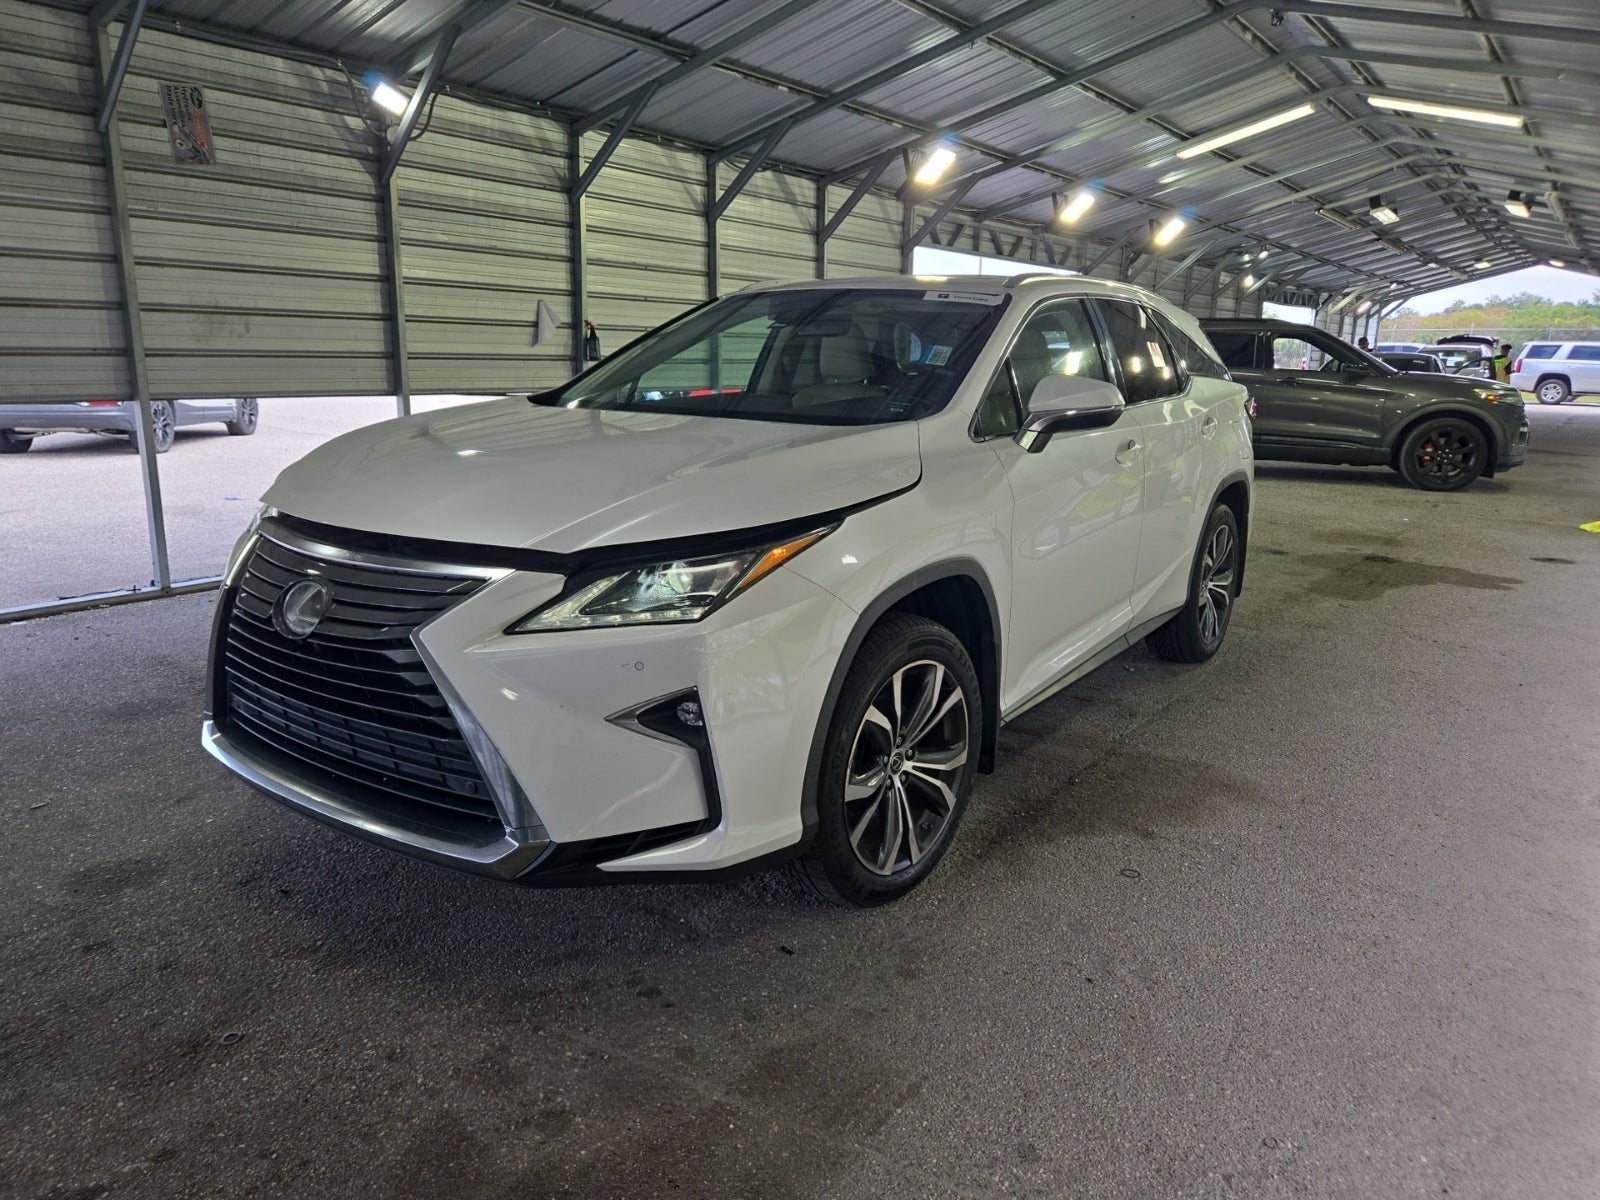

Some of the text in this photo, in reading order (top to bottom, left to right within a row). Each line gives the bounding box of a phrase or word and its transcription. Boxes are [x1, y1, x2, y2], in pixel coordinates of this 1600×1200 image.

[166, 85, 178, 125] Made Here
[174, 86, 186, 127] Assemblies
[181, 86, 192, 121] Hydraulic
